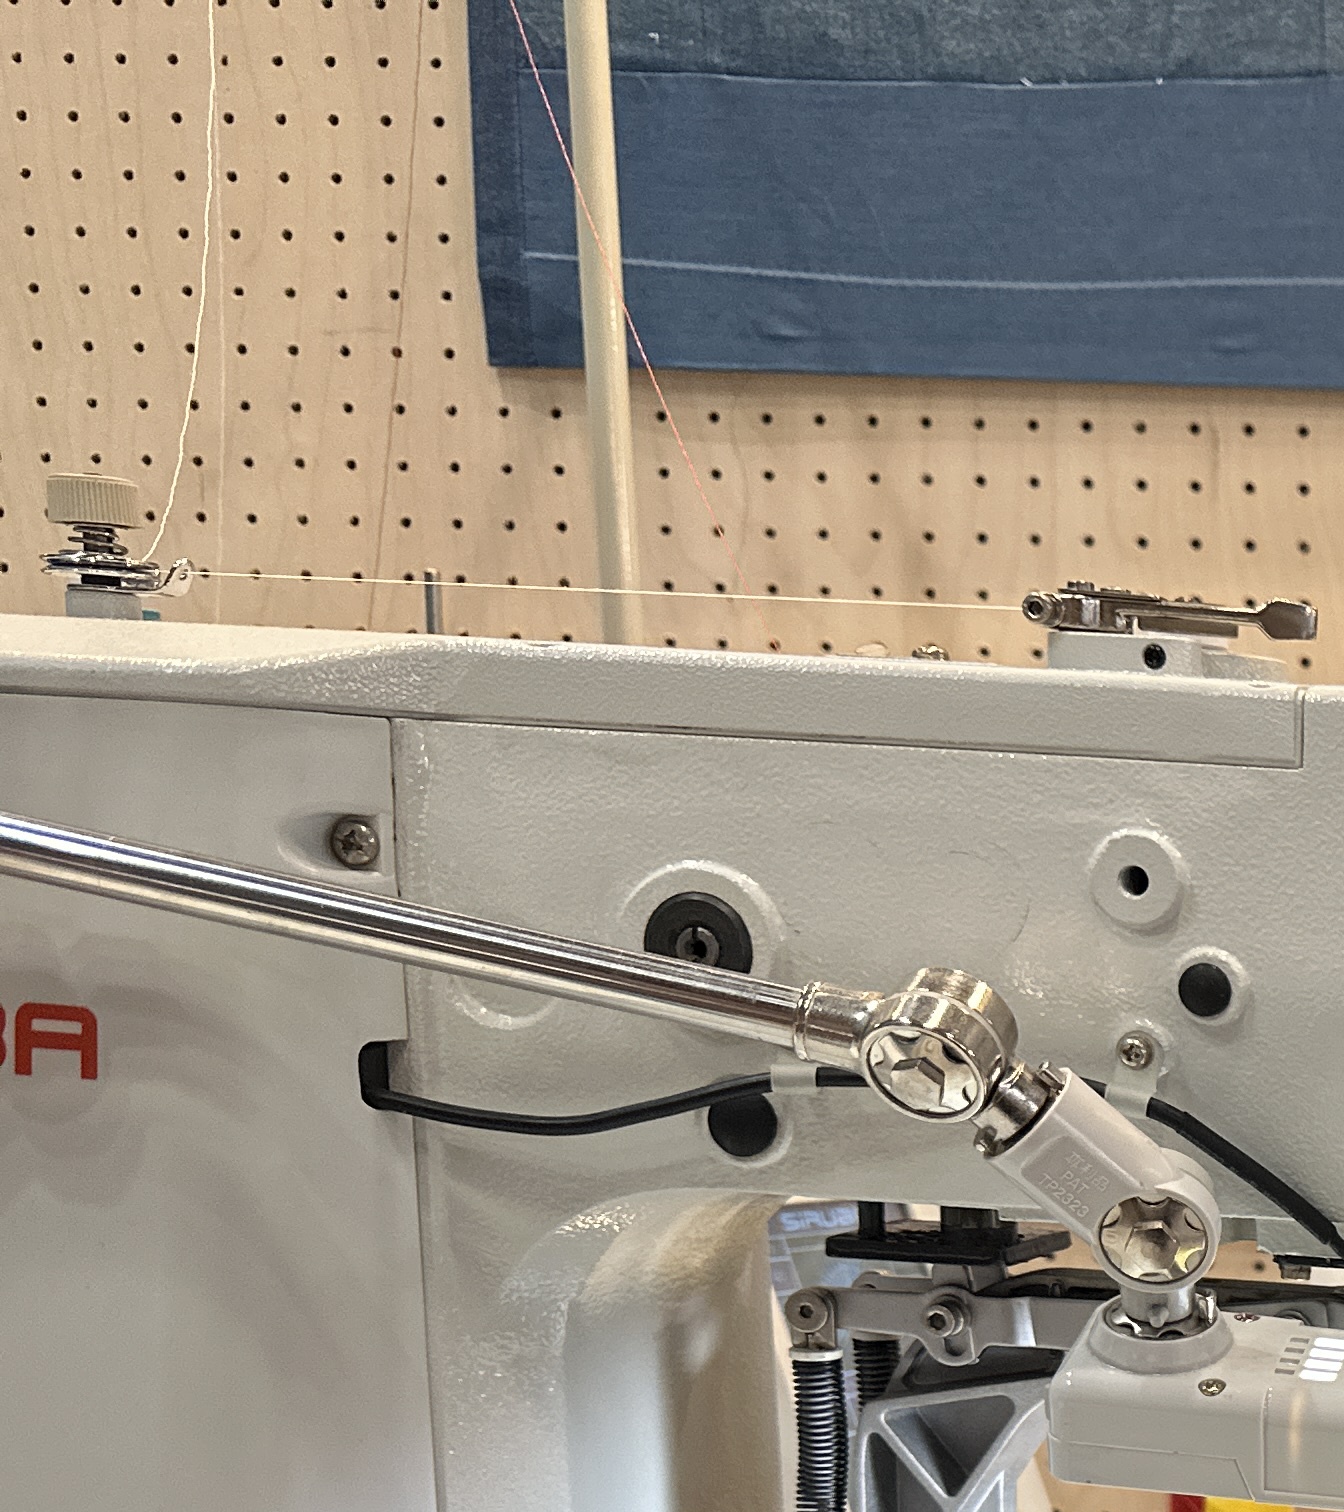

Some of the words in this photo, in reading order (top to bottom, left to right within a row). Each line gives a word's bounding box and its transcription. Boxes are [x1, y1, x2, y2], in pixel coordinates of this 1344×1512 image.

[0, 1002, 98, 1080] A
[1039, 1173, 1090, 1217] TP2323
[1061, 1171, 1090, 1194] PAT
